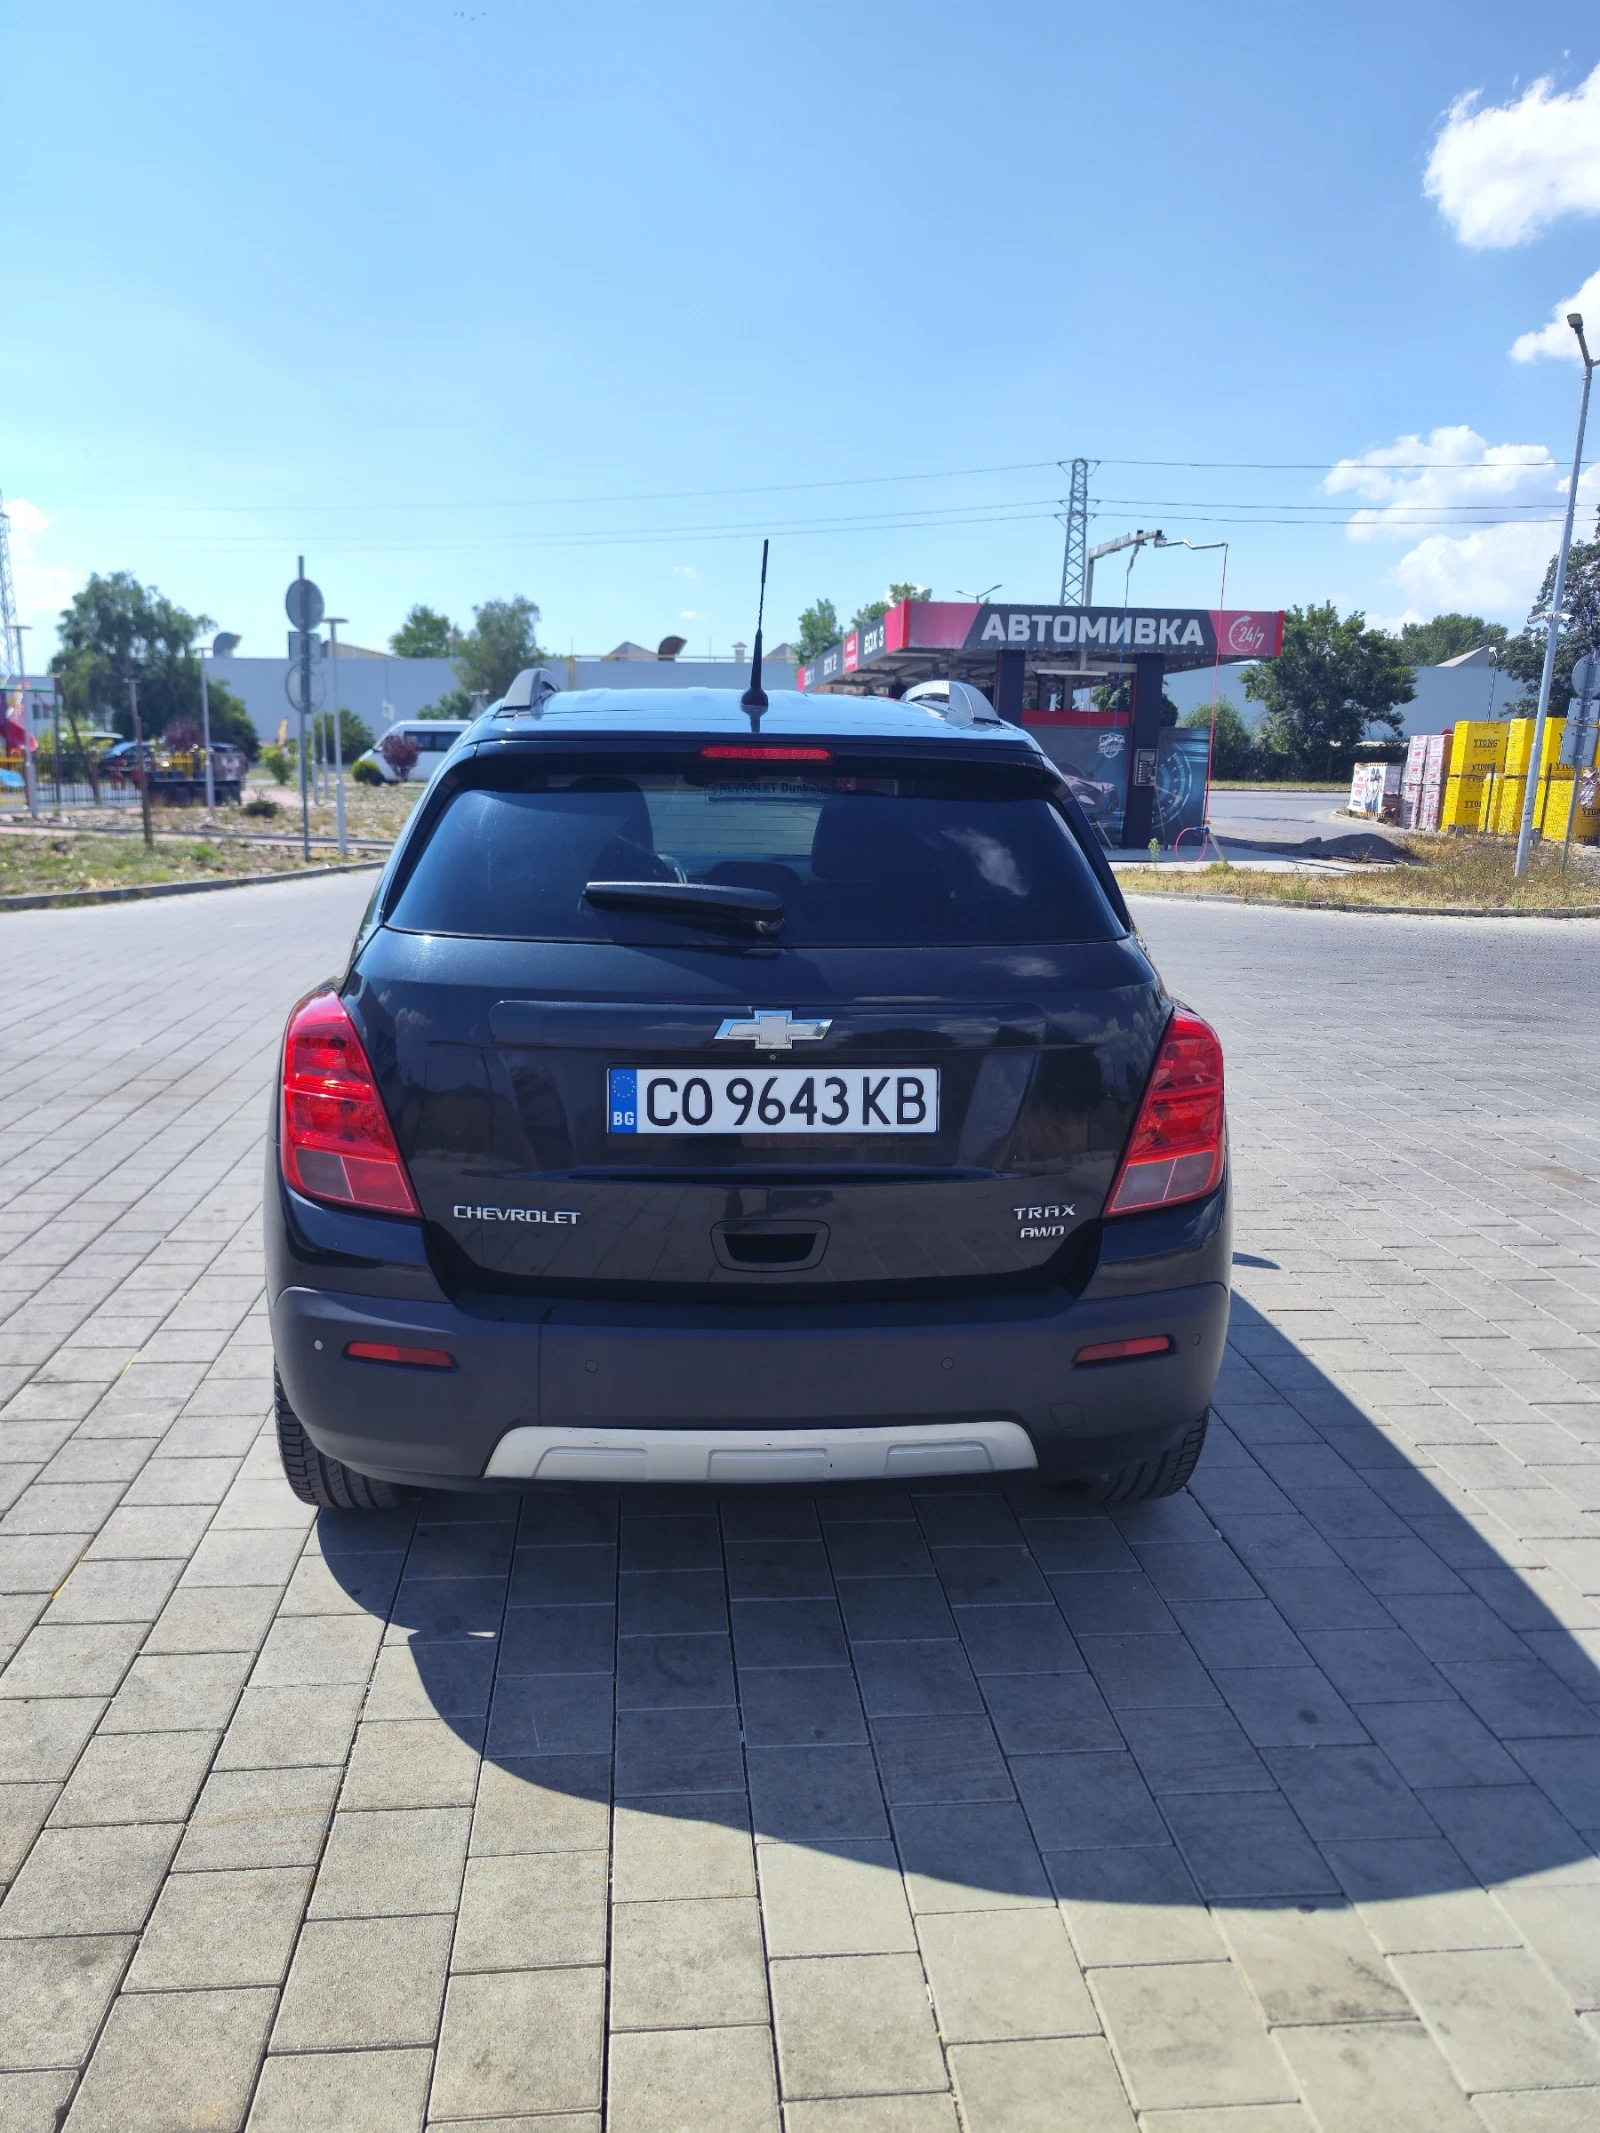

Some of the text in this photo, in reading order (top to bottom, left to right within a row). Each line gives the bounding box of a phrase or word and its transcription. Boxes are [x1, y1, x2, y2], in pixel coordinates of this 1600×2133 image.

[981, 613, 1204, 646] АВТОМИВКА
[1238, 626, 1264, 649] 24/7
[1473, 739, 1498, 748] YTONG
[646, 1076, 927, 1127] CO 9643 KB
[613, 1111, 635, 1126] BG
[453, 1205, 581, 1225] CHEVROLET
[1013, 1203, 1076, 1220] TRAX
[1020, 1225, 1065, 1239] AWD
